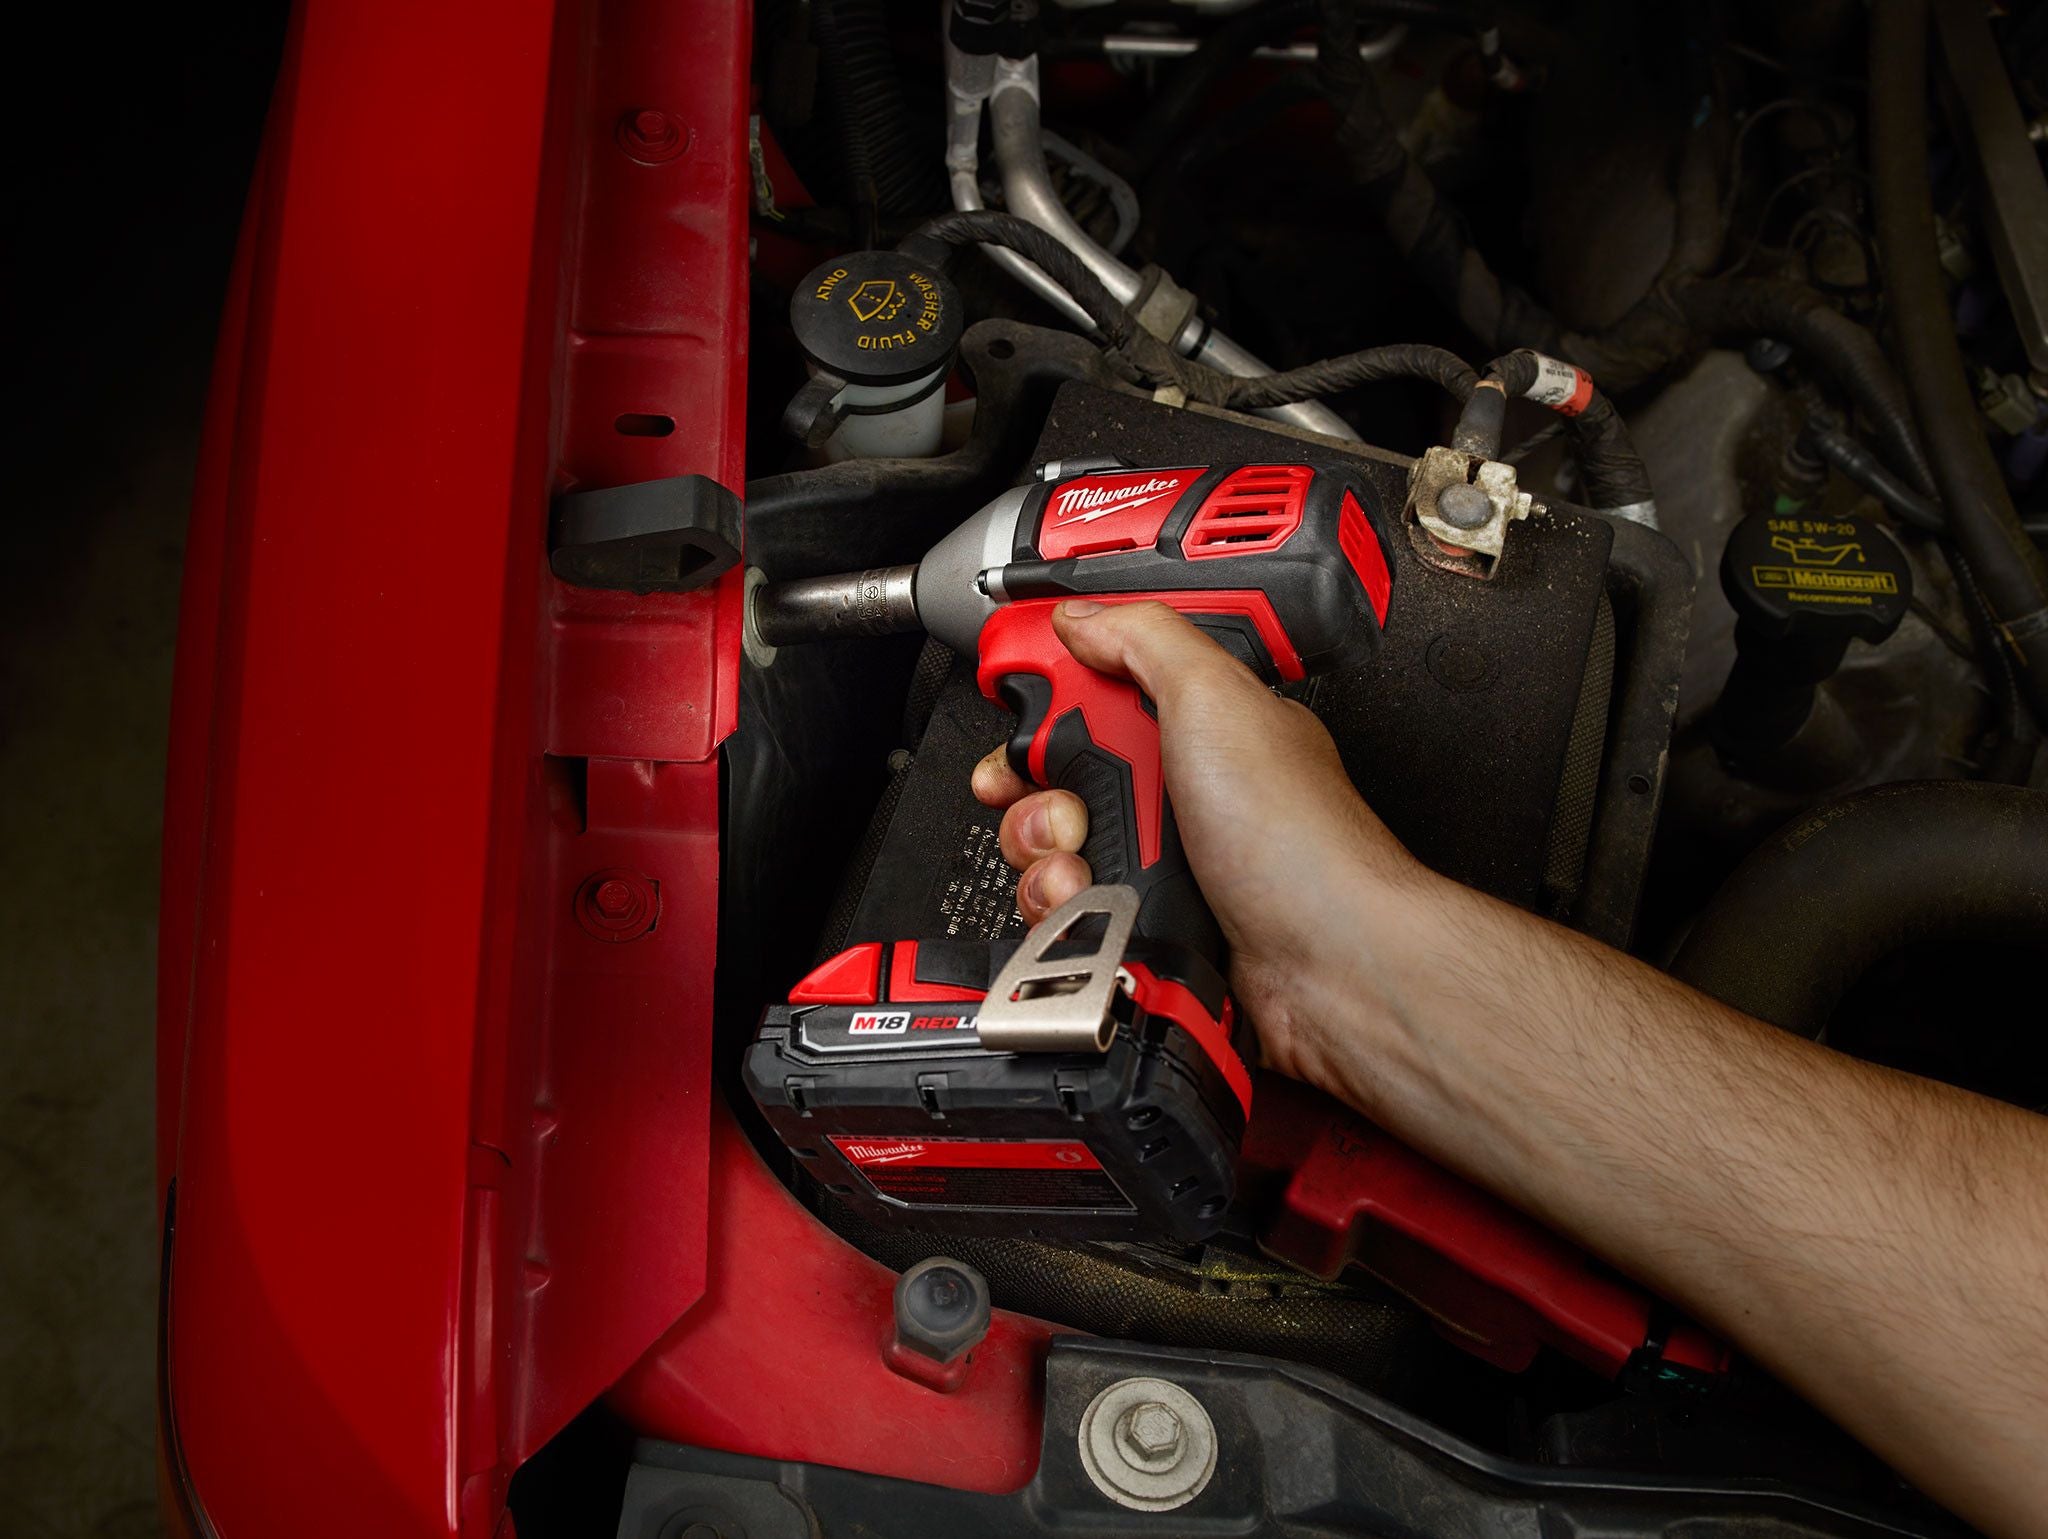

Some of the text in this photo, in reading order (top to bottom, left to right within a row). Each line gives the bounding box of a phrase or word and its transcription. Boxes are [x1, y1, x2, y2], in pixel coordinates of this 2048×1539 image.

[815, 268, 939, 350] WASHER FLUID ONLY
[1056, 478, 1181, 517] Milwaukee
[1767, 518, 1857, 537] SAE 5W-20
[1794, 569, 1890, 590] Motorcraft
[1787, 591, 1873, 606] Recommended
[854, 1015, 977, 1030] M18 REDLI
[845, 1143, 926, 1160] Milwaukee
